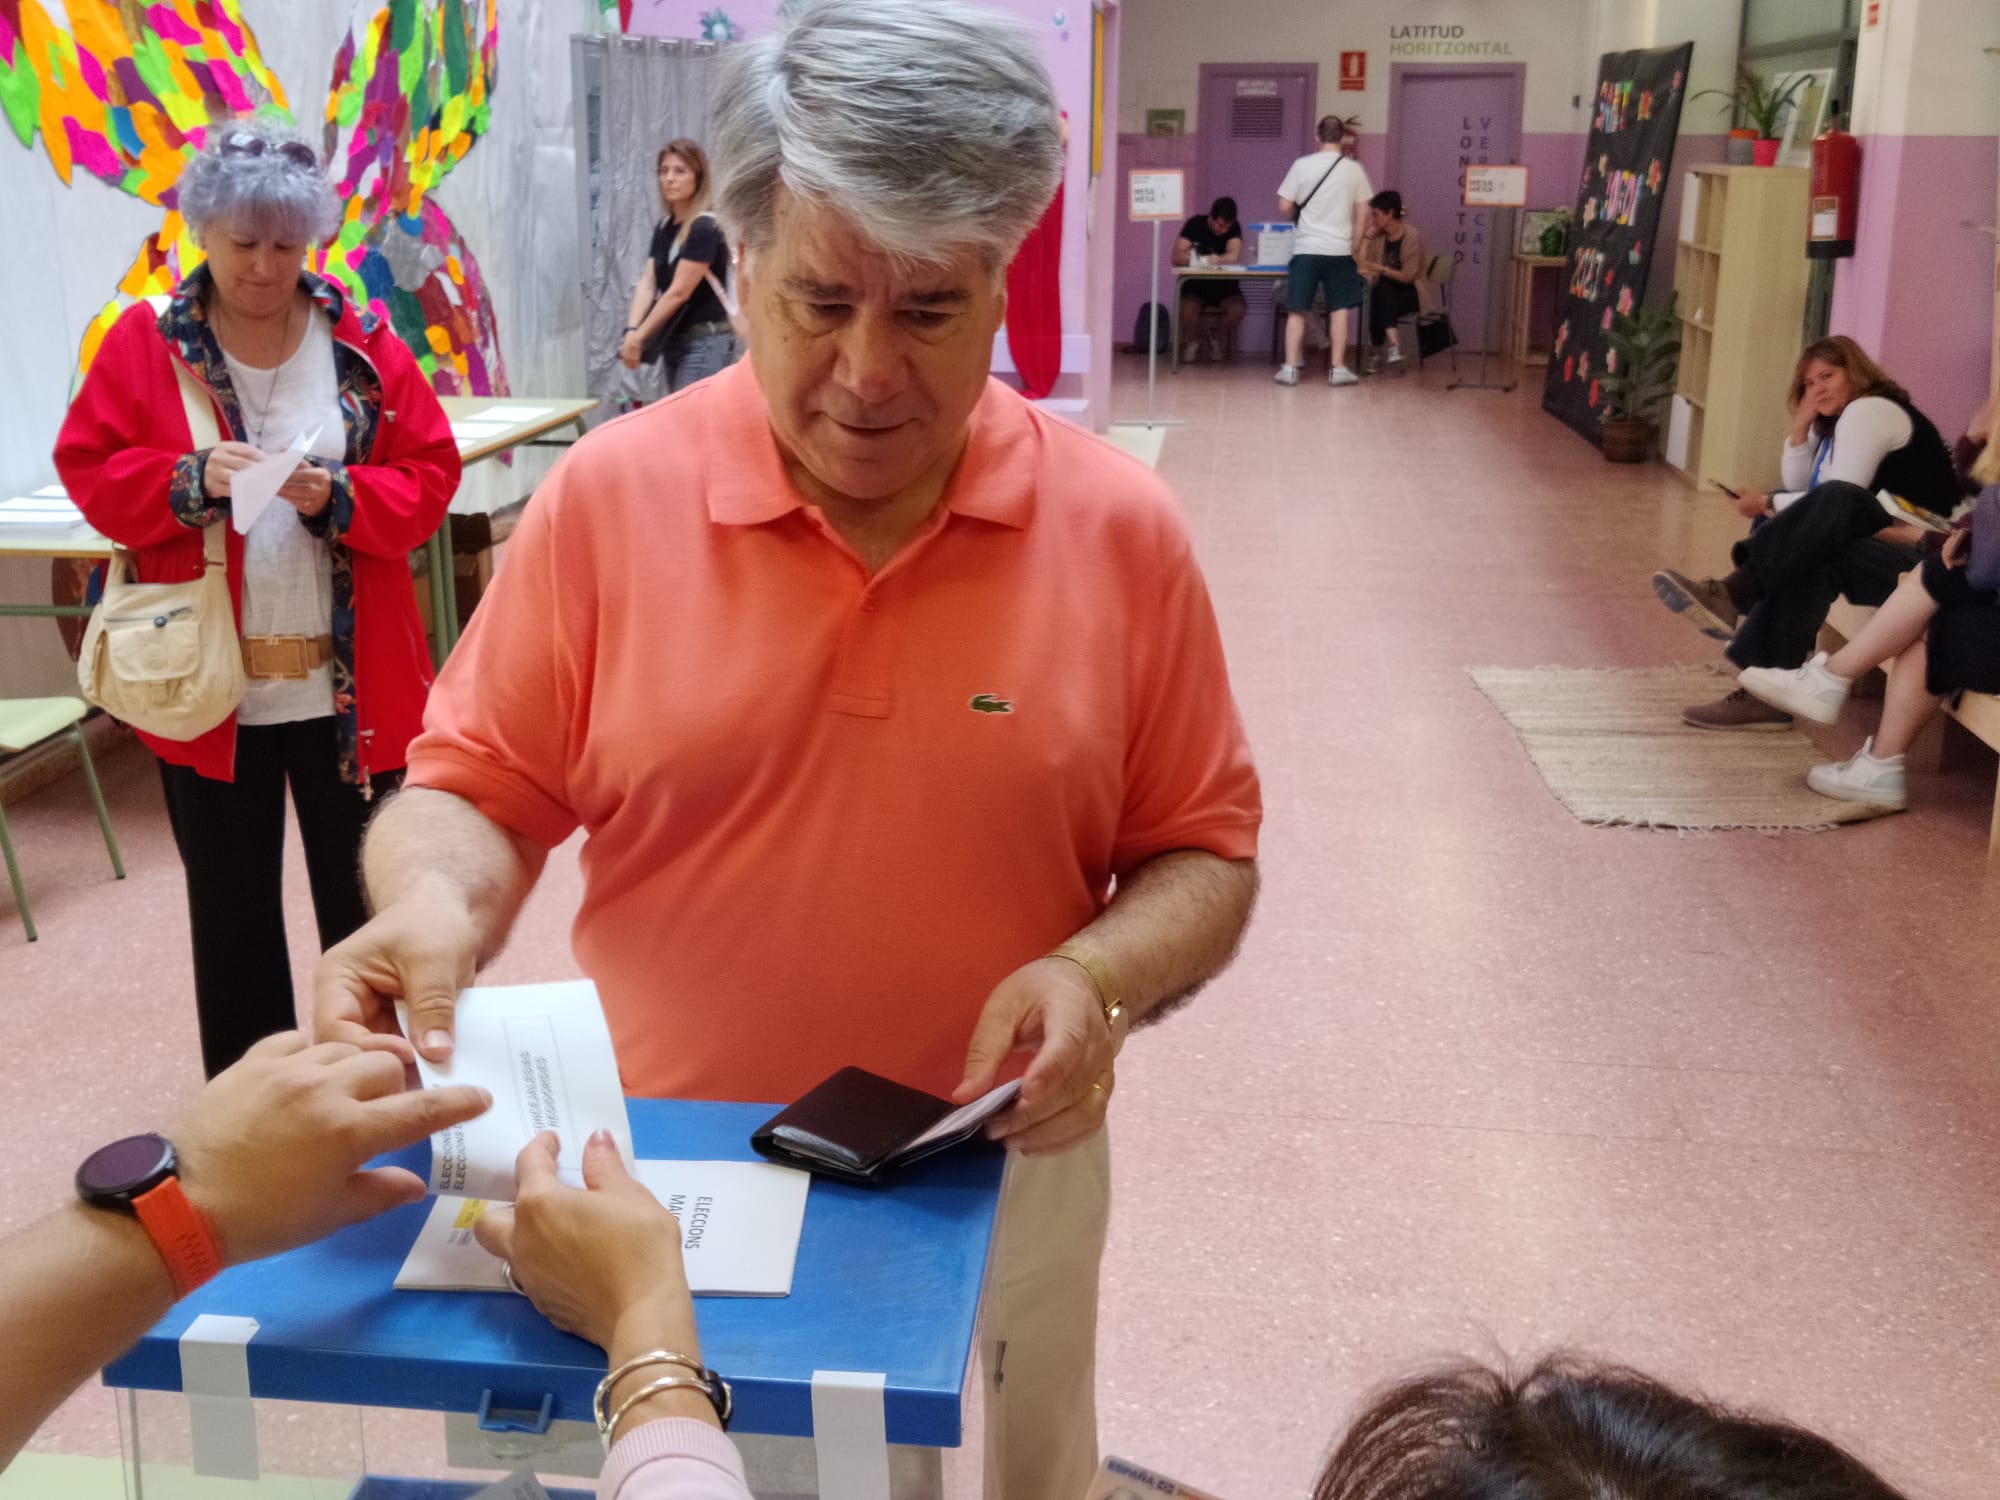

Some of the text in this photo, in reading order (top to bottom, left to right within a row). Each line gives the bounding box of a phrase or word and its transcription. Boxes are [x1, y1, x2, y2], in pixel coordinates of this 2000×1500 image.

[1390, 25, 1465, 39] LATITUD
[1390, 41, 1513, 56] HORITZONTAL
[1472, 116, 1491, 265] VERCAL
[439, 1125, 453, 1190] ELECCIONE
[454, 1131, 467, 1191] ELECCIONS
[684, 1196, 713, 1249] ELECCIONS
